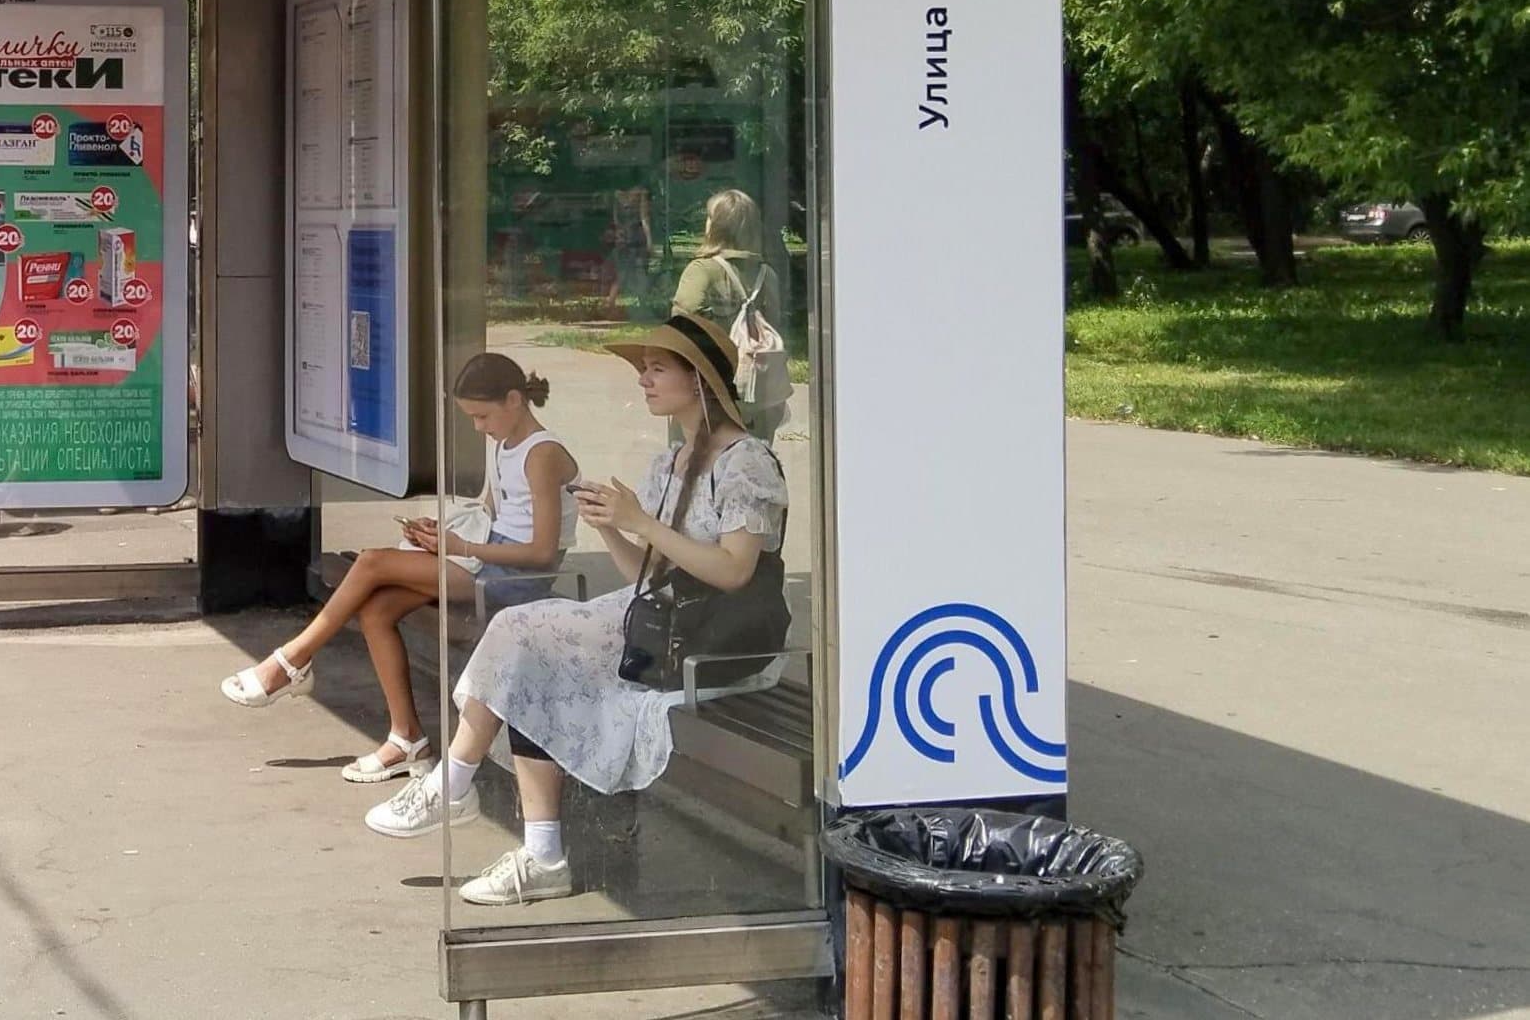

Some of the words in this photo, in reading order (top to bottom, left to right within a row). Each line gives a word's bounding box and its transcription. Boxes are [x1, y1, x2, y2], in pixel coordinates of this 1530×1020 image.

[918, 6, 953, 130] Улица
[65, 420, 151, 445] НЕОБХОДИМО
[57, 446, 151, 473] СПЕЦИАЛИСТА
